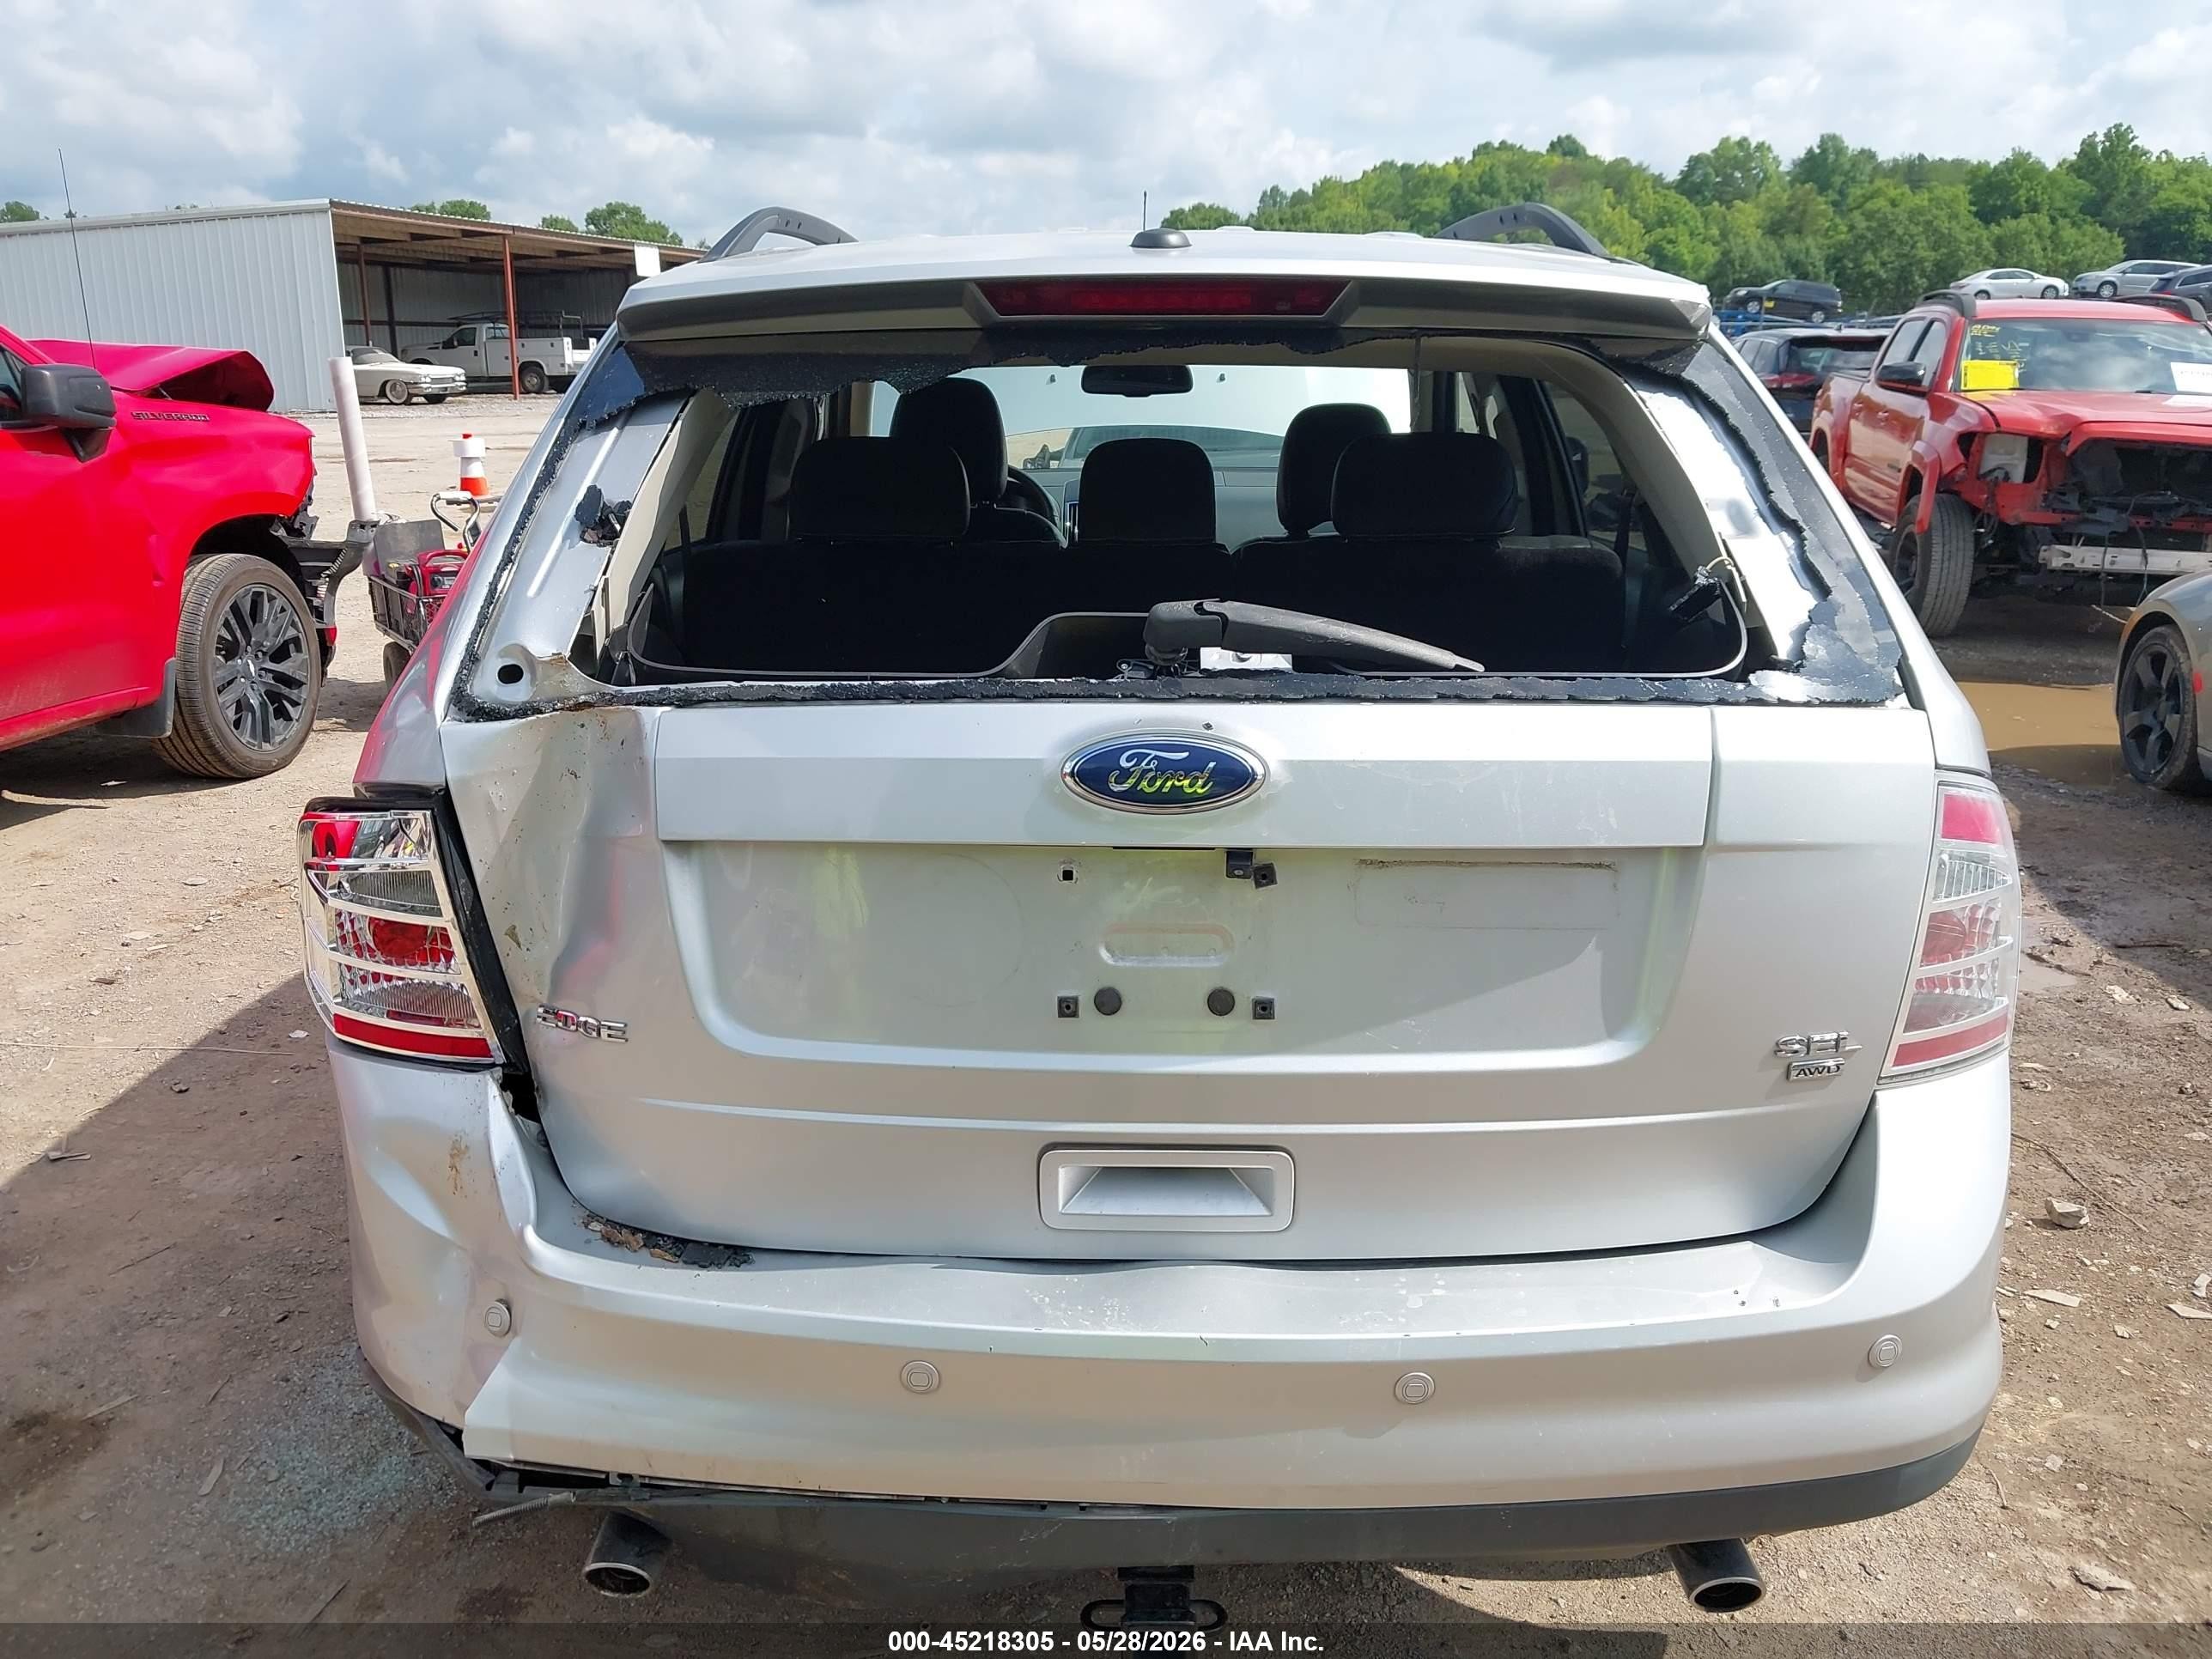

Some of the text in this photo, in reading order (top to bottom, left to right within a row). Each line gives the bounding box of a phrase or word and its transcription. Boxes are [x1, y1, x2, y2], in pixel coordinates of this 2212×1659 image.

[1108, 748, 1217, 793] Ford
[536, 1004, 629, 1042] EDGE
[1774, 1030, 1863, 1057] SEL
[1795, 1065, 1841, 1078] AWD
